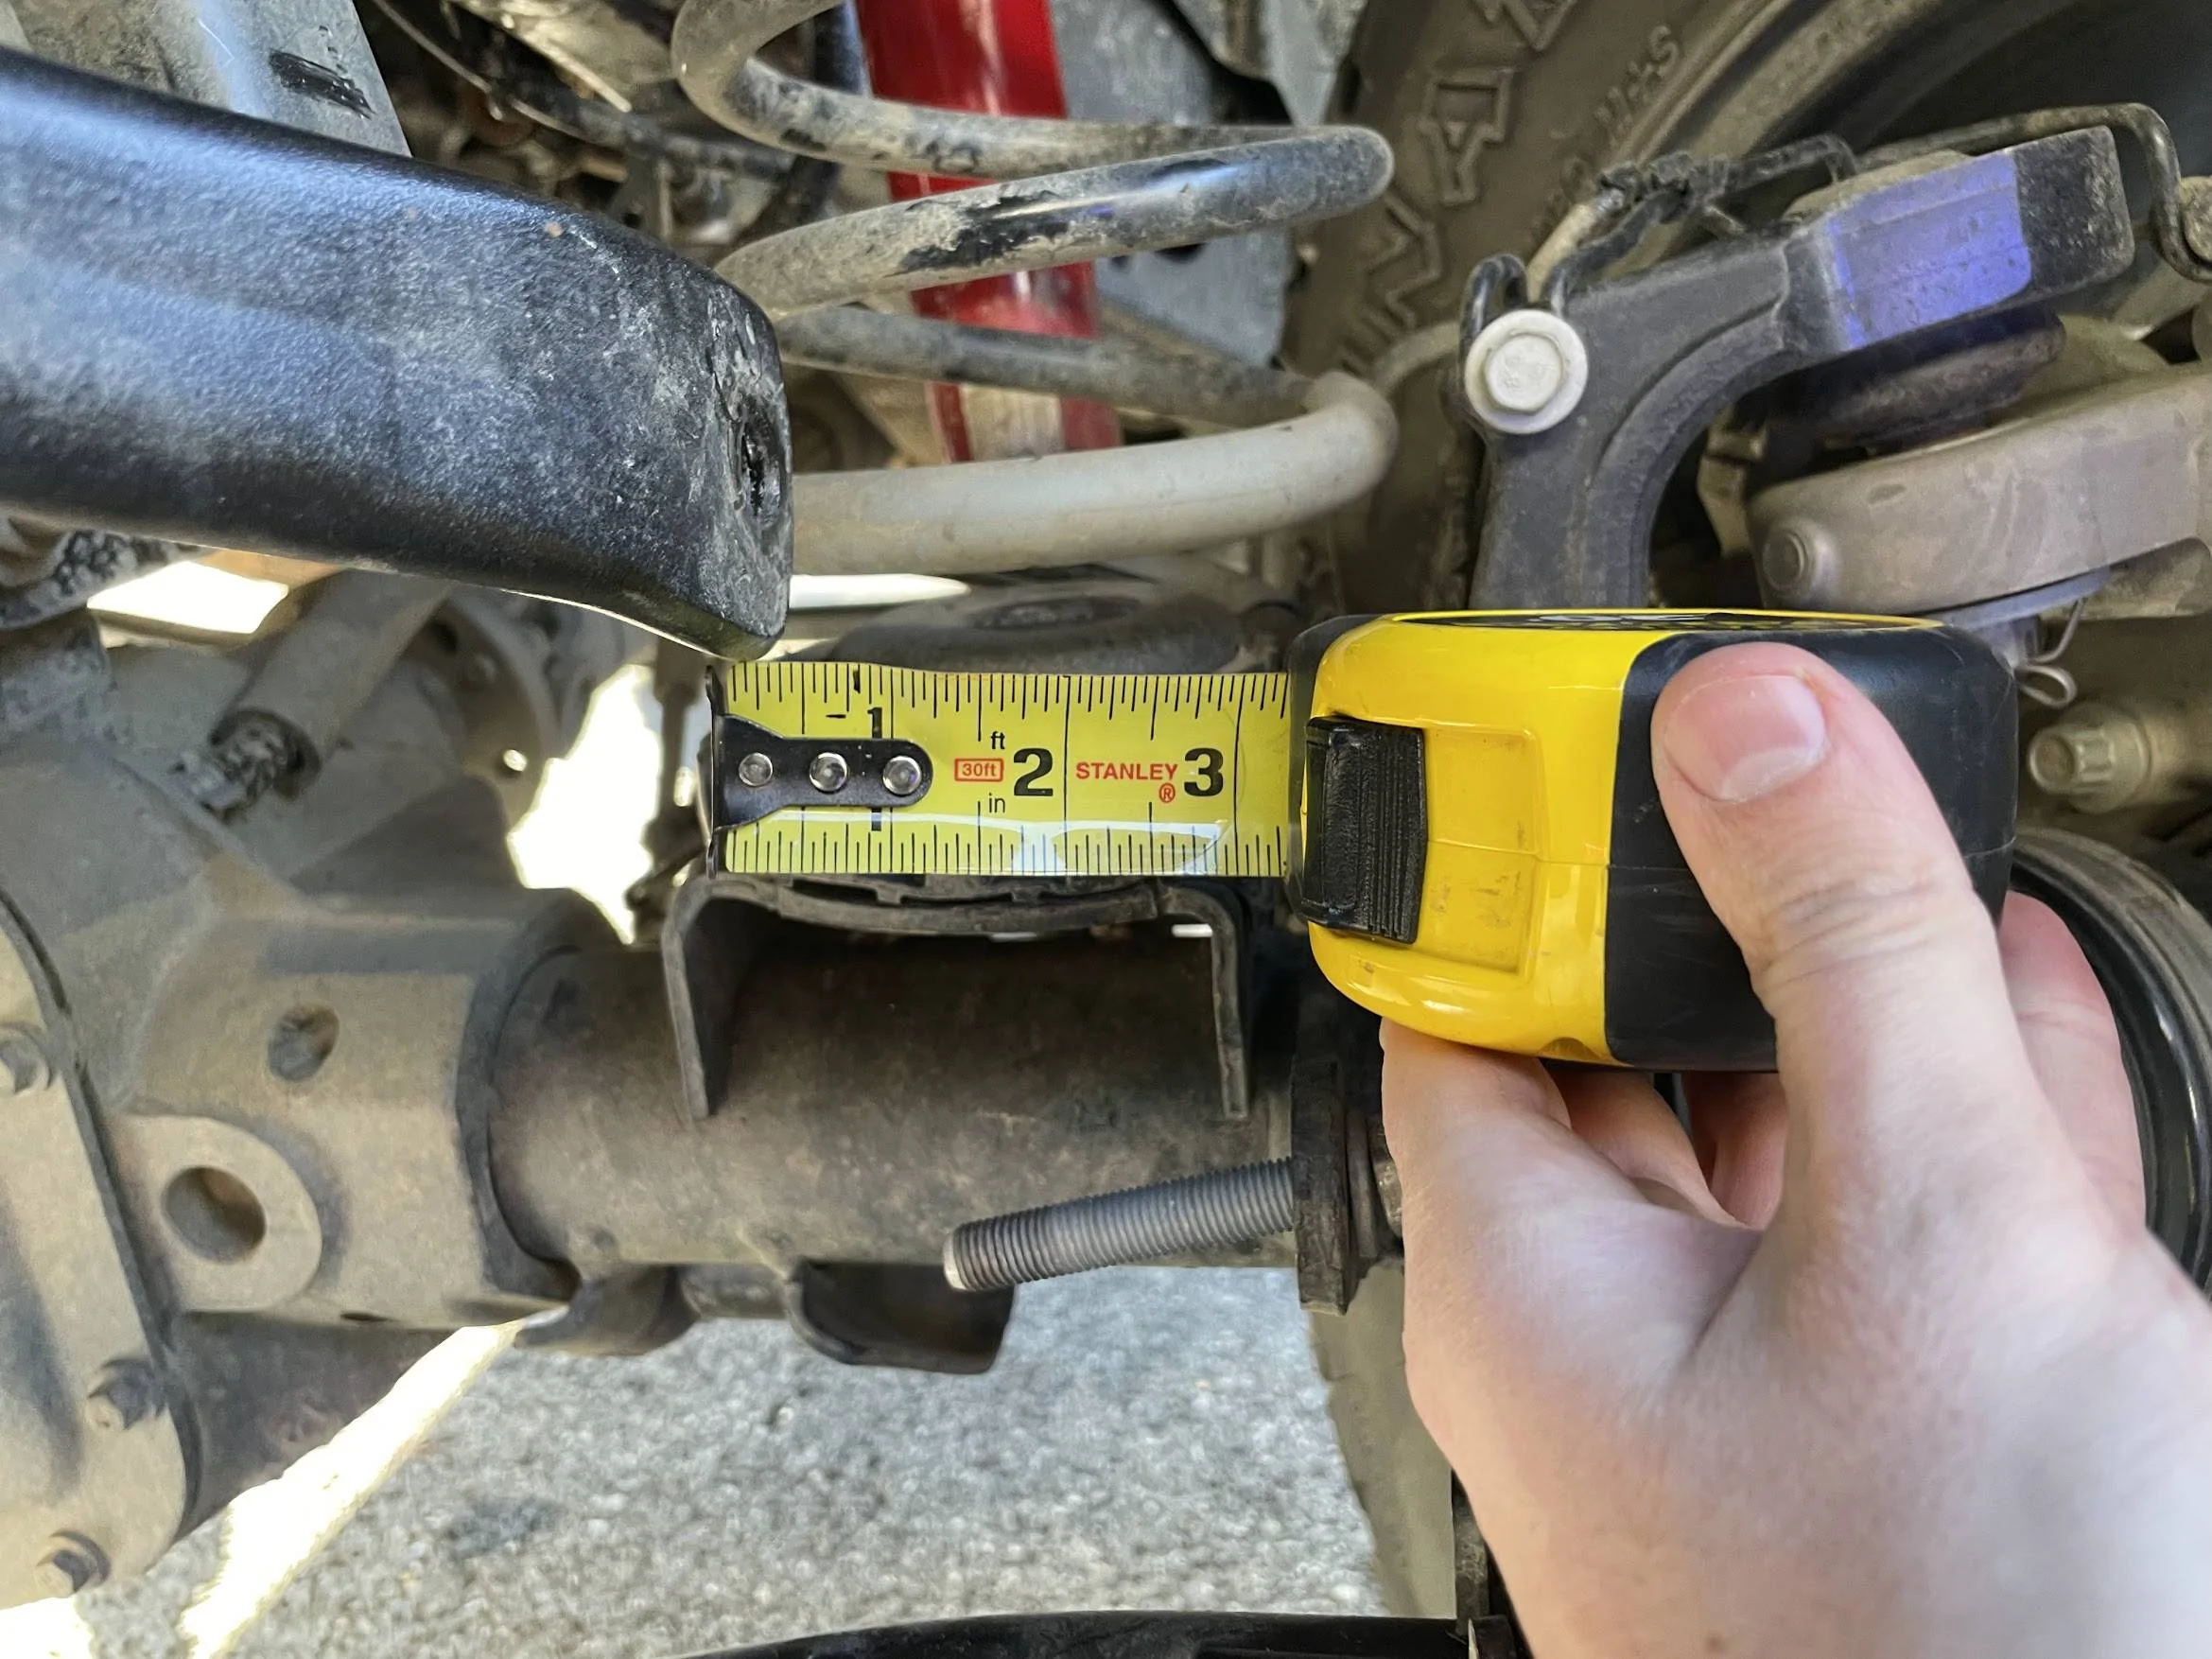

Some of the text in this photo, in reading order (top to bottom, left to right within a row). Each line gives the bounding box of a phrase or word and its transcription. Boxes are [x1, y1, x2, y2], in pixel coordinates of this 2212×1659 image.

[990, 730, 1005, 750] ft
[961, 761, 998, 777] 30ft
[1013, 747, 1054, 797] 2
[1075, 761, 1178, 781] STANLEY
[1183, 747, 1224, 797] 3
[988, 792, 1006, 813] in
